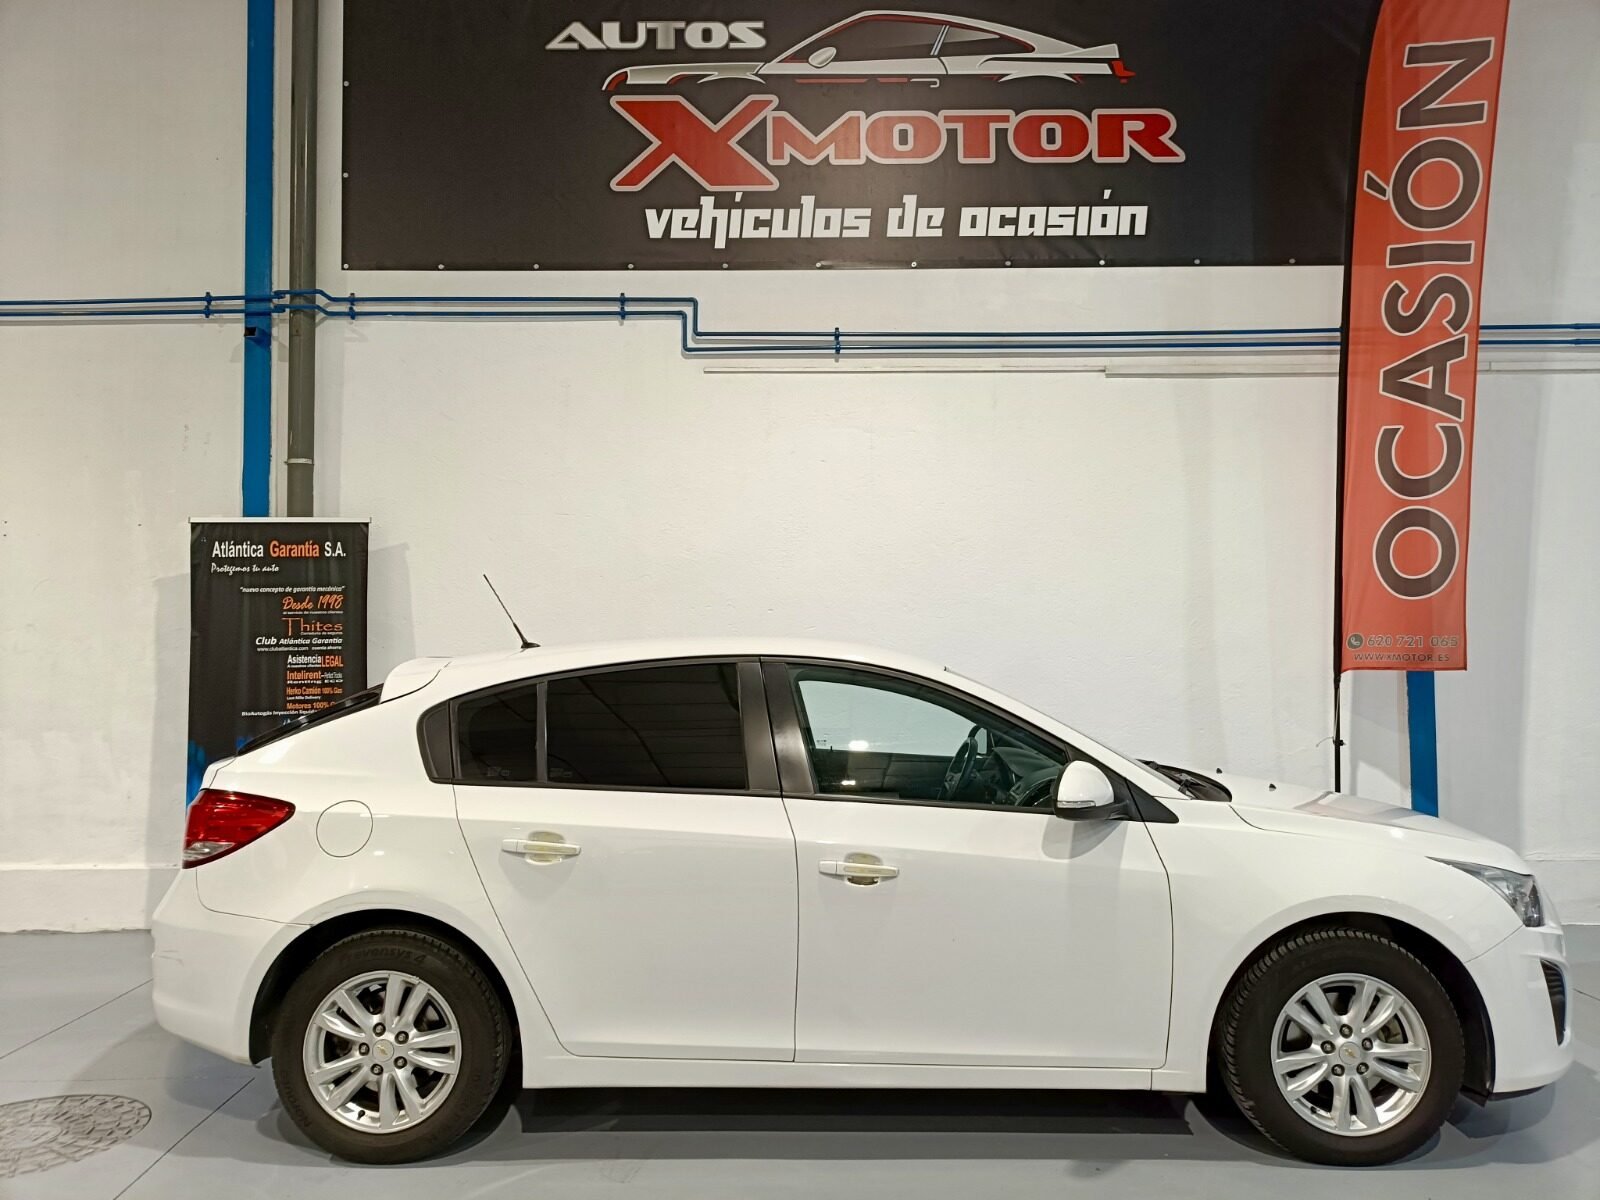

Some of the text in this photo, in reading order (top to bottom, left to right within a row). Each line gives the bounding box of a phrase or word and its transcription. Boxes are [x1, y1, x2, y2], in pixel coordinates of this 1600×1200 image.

[545, 20, 766, 50] AUTOS
[644, 189, 1148, 249] vehículos de ocasión
[1364, 37, 1495, 600] OCASIÓN
[211, 539, 346, 558] Atlántica Garantía S.A.
[211, 562, 280, 576] Protegemos tu auto
[282, 594, 344, 610] Desde 1998
[281, 617, 344, 636] Thites
[255, 636, 343, 646] Club Atlántica Garantía
[1366, 635, 1393, 648] 620
[1396, 635, 1424, 648] 721
[287, 654, 344, 667] Asistencia LEGAL
[287, 702, 311, 710] Motores
